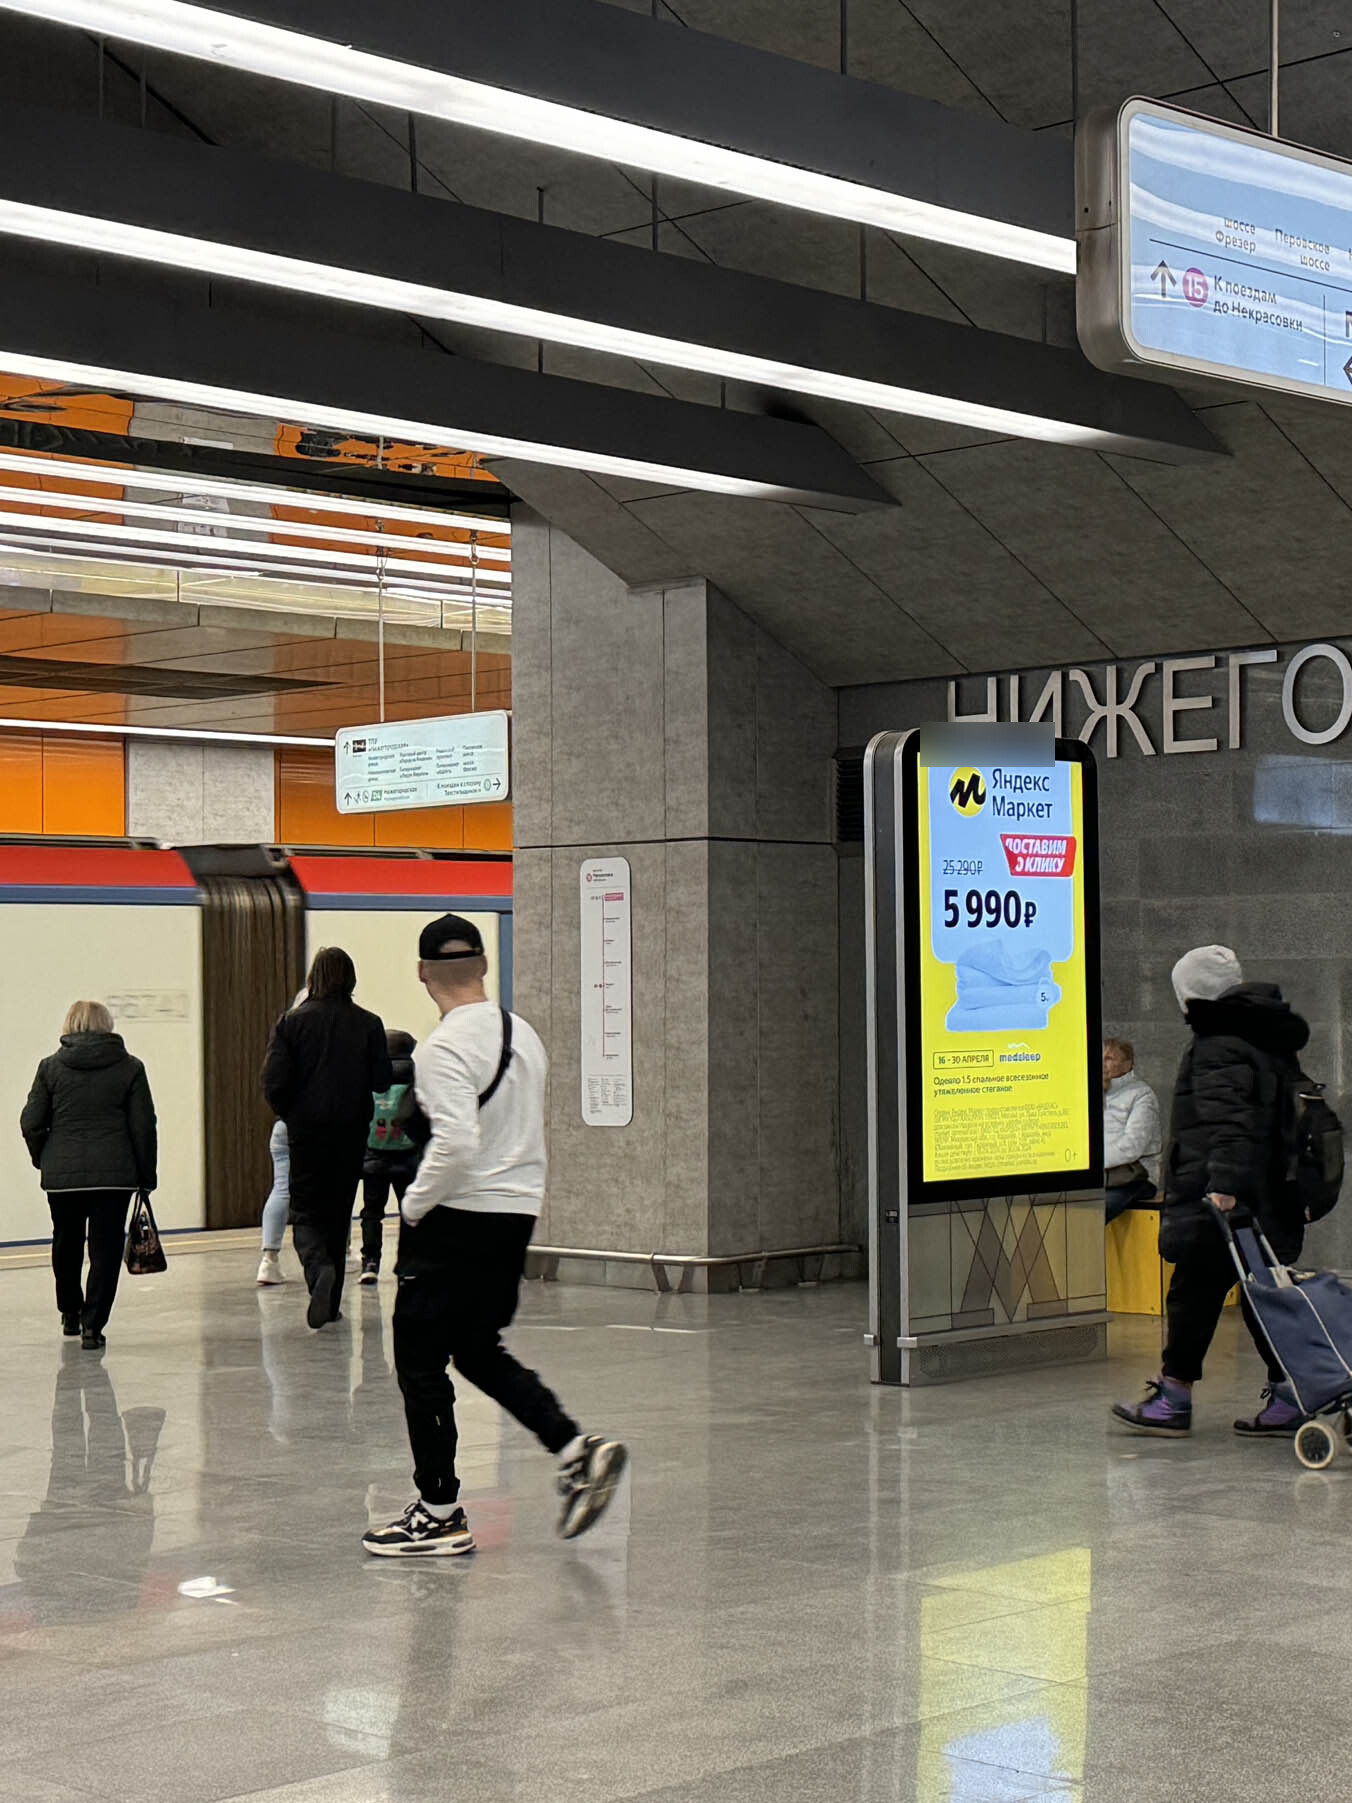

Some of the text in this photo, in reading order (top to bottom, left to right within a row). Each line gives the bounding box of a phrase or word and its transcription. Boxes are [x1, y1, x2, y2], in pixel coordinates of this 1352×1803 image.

[1224, 216, 1256, 235] шоссе
[1215, 230, 1256, 253] Фрезер
[1274, 228, 1331, 255] Перовское
[1299, 254, 1331, 272] шоссе
[1185, 275, 1205, 300] 15
[1213, 275, 1278, 305] К поездам
[1212, 300, 1304, 333] до Некрасовки
[992, 768, 1050, 793] Яндекс
[992, 795, 1053, 821] Маркет
[1025, 856, 1066, 873] КЛИКУ
[938, 1056, 946, 1065] 16
[952, 1055, 961, 1064] 30
[962, 1054, 990, 1064] АПРЕЛЯ
[1064, 1148, 1078, 1163] 0+
